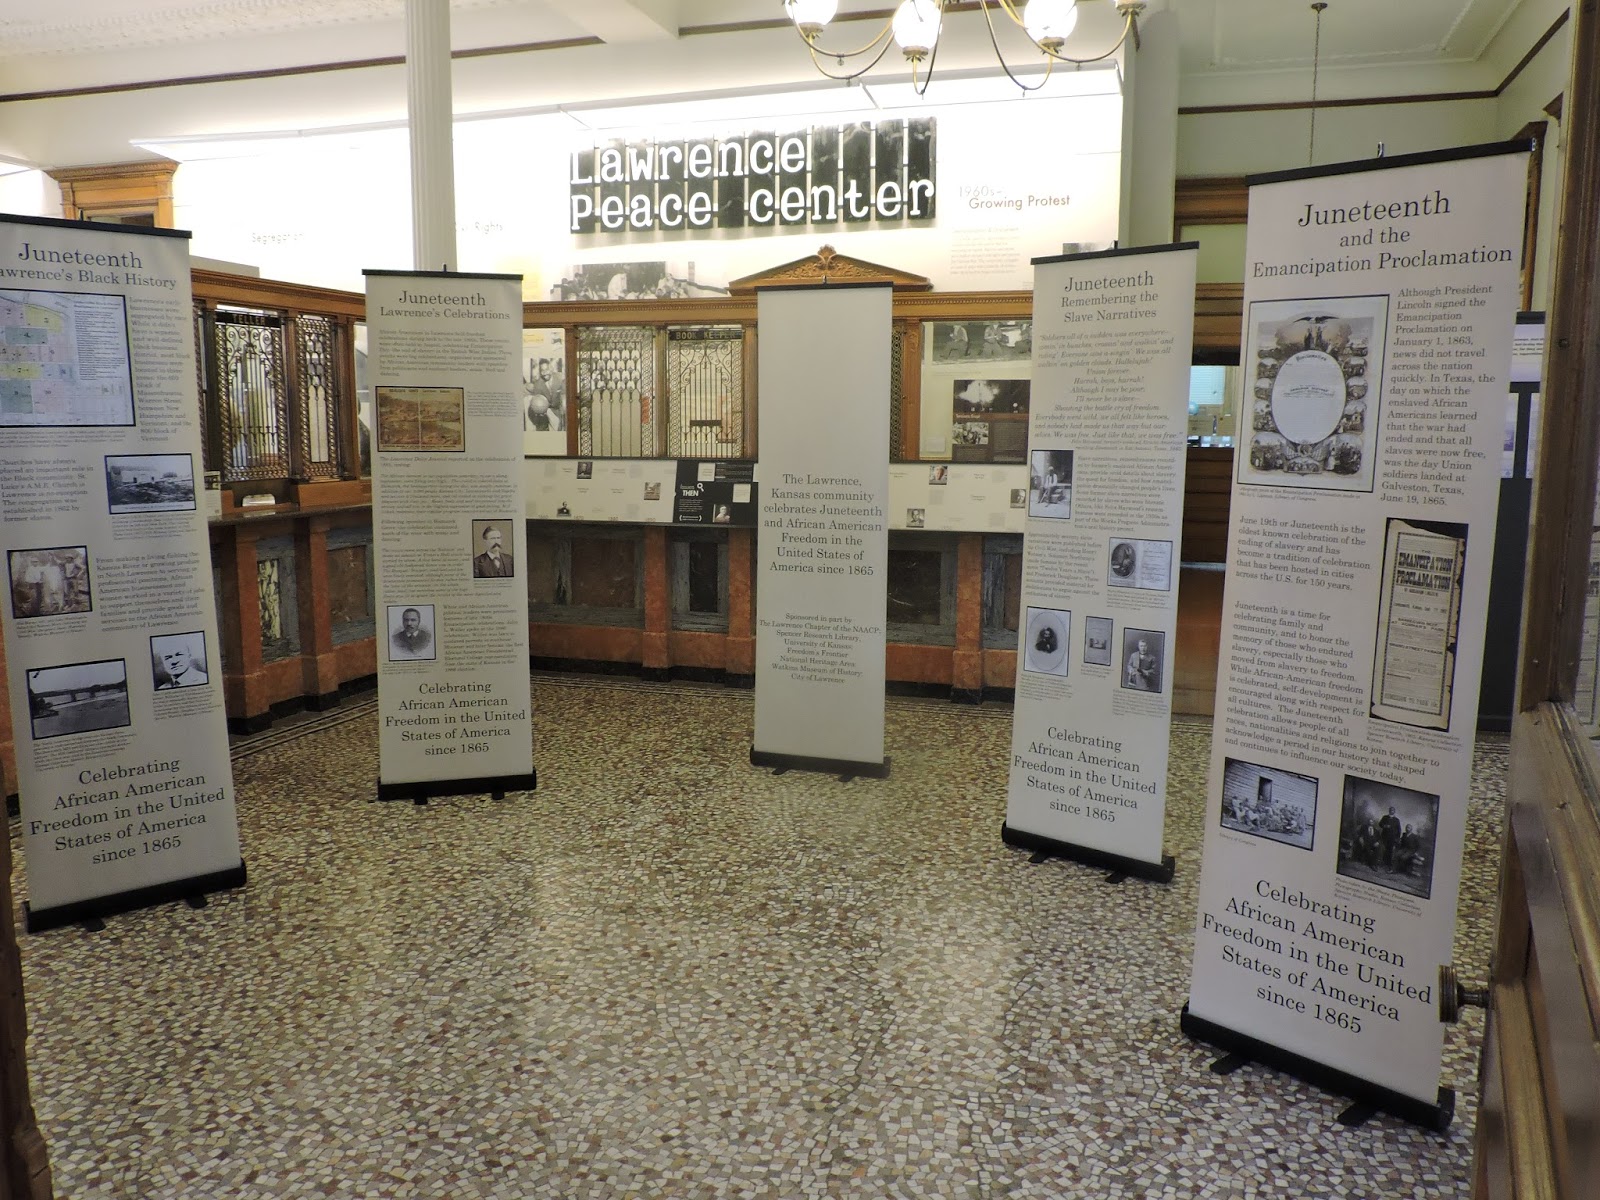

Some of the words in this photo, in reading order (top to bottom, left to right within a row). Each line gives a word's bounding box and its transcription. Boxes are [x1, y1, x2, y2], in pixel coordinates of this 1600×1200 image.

[570, 137, 804, 184] Lawrence
[570, 192, 713, 230] Peace
[750, 179, 934, 221] center
[969, 197, 1022, 210] Growing
[1028, 195, 1070, 207] Protest
[1297, 191, 1451, 226] Juneteenth
[1339, 228, 1374, 247] and
[1380, 226, 1411, 244] the
[18, 244, 143, 268] Juneteenth
[1252, 256, 1372, 278] Emancipation
[1378, 247, 1513, 270] Proclamation
[0, 269, 73, 281] awrence's
[78, 271, 120, 284] Black
[125, 274, 177, 290] History
[1064, 271, 1154, 292] Juneteenth
[1398, 286, 1441, 297] Although
[1444, 284, 1493, 295] President
[399, 291, 486, 306] Juneteenth
[1061, 293, 1136, 307] Remembering
[1139, 291, 1159, 302] the
[1397, 299, 1432, 309] Lincoln
[1434, 298, 1466, 309] signed
[1469, 297, 1486, 307] the
[233, 314, 266, 326] TELLER
[380, 307, 440, 318] Lawrence's
[443, 308, 511, 320] Celebrations
[1064, 312, 1093, 322] Slave
[1096, 309, 1157, 321] Narratives
[1396, 311, 1462, 322] Emancipation
[676, 332, 696, 340] BOOK
[1395, 324, 1458, 334] Proclamation
[1393, 337, 1433, 347] January
[1435, 337, 1444, 346] 1,
[1447, 336, 1474, 346] 1863,
[782, 474, 804, 485] The
[807, 475, 862, 488] Lawrence,
[1381, 481, 1430, 493] Galveston,
[1433, 484, 1465, 495] Texas,
[771, 488, 811, 499] Kansas
[813, 491, 874, 504] community
[1380, 493, 1404, 503] June
[1406, 495, 1419, 505] 19,
[1423, 496, 1447, 505] 1865.
[763, 504, 817, 515] celebrates
[819, 505, 882, 517] Juneteenth
[764, 518, 783, 528] and
[786, 518, 826, 529] African
[828, 520, 882, 531] American
[1239, 515, 1258, 524] June
[1260, 517, 1278, 526] 19th
[1290, 520, 1339, 532] Juneteenth
[1341, 525, 1349, 533] is
[1351, 526, 1366, 534] the
[781, 533, 828, 544] Freedom
[831, 535, 843, 545] in
[845, 535, 863, 545] the
[777, 547, 813, 558] United
[816, 548, 851, 559] States
[853, 550, 865, 560] of
[769, 562, 814, 573] America
[817, 564, 845, 574] since
[848, 565, 874, 575] 1865
[1235, 572, 1258, 580] across
[1260, 573, 1274, 581] the
[1275, 574, 1293, 584] U.S.
[1295, 577, 1308, 586] for
[1310, 579, 1325, 588] 150
[1327, 583, 1353, 591] years.
[759, 619, 771, 627] The
[771, 620, 803, 629] Lawrence
[804, 622, 831, 632] Chapter
[841, 624, 852, 632] the
[785, 613, 819, 622] Sponsored
[828, 616, 842, 624] part
[843, 616, 853, 625] by
[776, 629, 802, 639] Spencer
[803, 631, 833, 639] Research
[784, 638, 818, 649] University
[787, 647, 820, 656] Freedom's
[821, 649, 849, 657] Frontier
[780, 655, 808, 664] National
[809, 657, 838, 667] Heritage
[800, 664, 828, 673] Museum
[791, 673, 805, 683] City
[814, 674, 845, 683] Lawrence
[419, 682, 492, 694] Celebrating
[398, 699, 445, 710] African
[449, 696, 509, 708] American
[385, 714, 440, 727] Freedom
[444, 713, 456, 724] in
[459, 712, 480, 723] the
[484, 709, 526, 722] United
[401, 730, 442, 741] States
[444, 728, 457, 739] of
[459, 726, 511, 738] America
[1047, 726, 1122, 753] Celebrating
[424, 745, 457, 756] since
[460, 741, 490, 753] 1865
[1028, 741, 1073, 760] African
[1077, 750, 1140, 772] American
[78, 759, 180, 785] Celebrating
[1014, 755, 1065, 776] Freedom
[1069, 767, 1082, 779] in
[1086, 770, 1107, 784] the
[1111, 775, 1156, 794] United
[52, 791, 119, 810] African
[125, 776, 206, 797] American
[1027, 775, 1065, 794] States
[1069, 785, 1082, 797] of
[1083, 787, 1138, 809] America
[29, 813, 108, 835] Freedom
[114, 807, 131, 820] in
[136, 800, 164, 816] the
[169, 787, 225, 810] United
[1050, 800, 1081, 815] since
[1085, 806, 1116, 822] 1865
[54, 831, 111, 850] States
[116, 823, 135, 839] of
[137, 813, 206, 835] America
[92, 848, 136, 864] since
[142, 836, 182, 855] 1865
[1256, 879, 1376, 935] Celebrating
[1225, 895, 1295, 932] African
[1302, 920, 1405, 967] American
[1202, 912, 1282, 953] Freedom
[1290, 942, 1308, 962] in
[1316, 951, 1349, 976] the
[1357, 965, 1432, 1004] United
[1222, 944, 1281, 979] States
[1288, 971, 1308, 989] of
[1311, 975, 1400, 1021] America
[1257, 986, 1306, 1014] since
[1314, 1003, 1362, 1034] 1865
